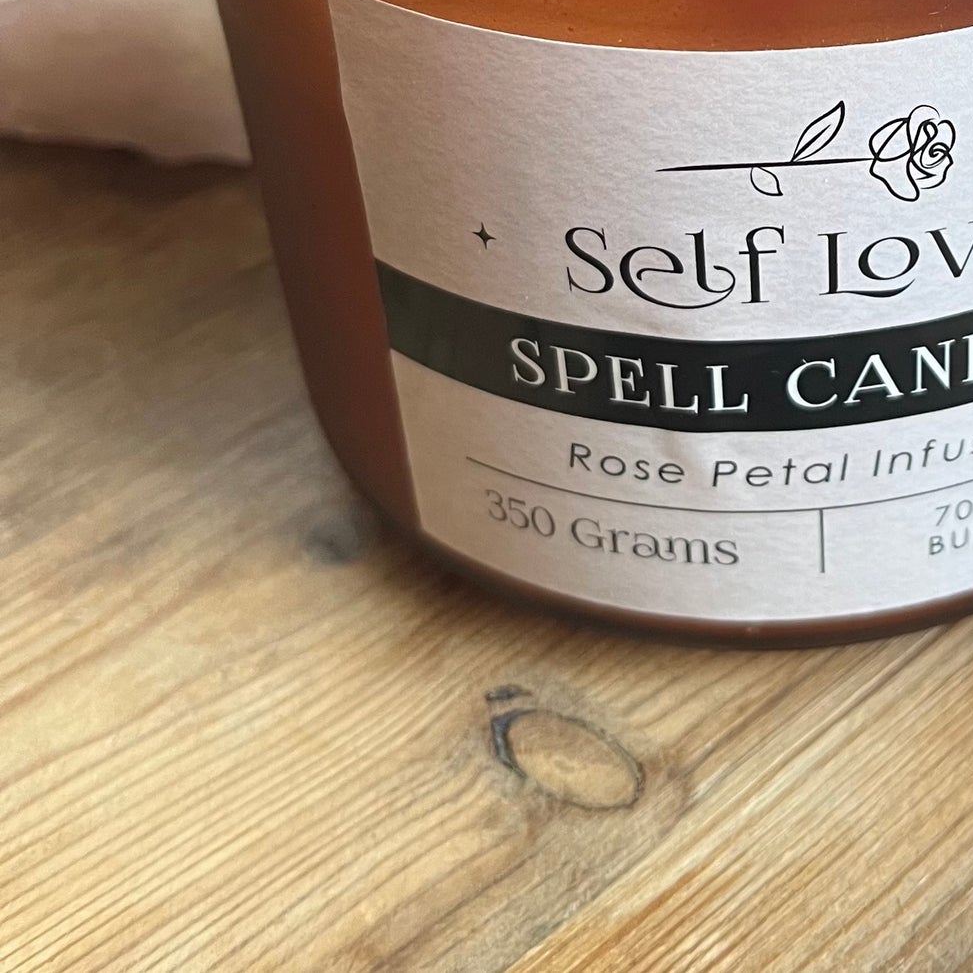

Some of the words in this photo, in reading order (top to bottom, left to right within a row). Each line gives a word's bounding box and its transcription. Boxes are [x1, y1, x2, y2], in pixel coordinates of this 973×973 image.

[566, 226, 785, 310] Self
[510, 337, 750, 415] SPELL
[568, 442, 686, 485] Rose
[712, 453, 849, 488] Petal
[486, 489, 557, 539] 350
[571, 516, 740, 568] Grams
[934, 498, 973, 528] 70
